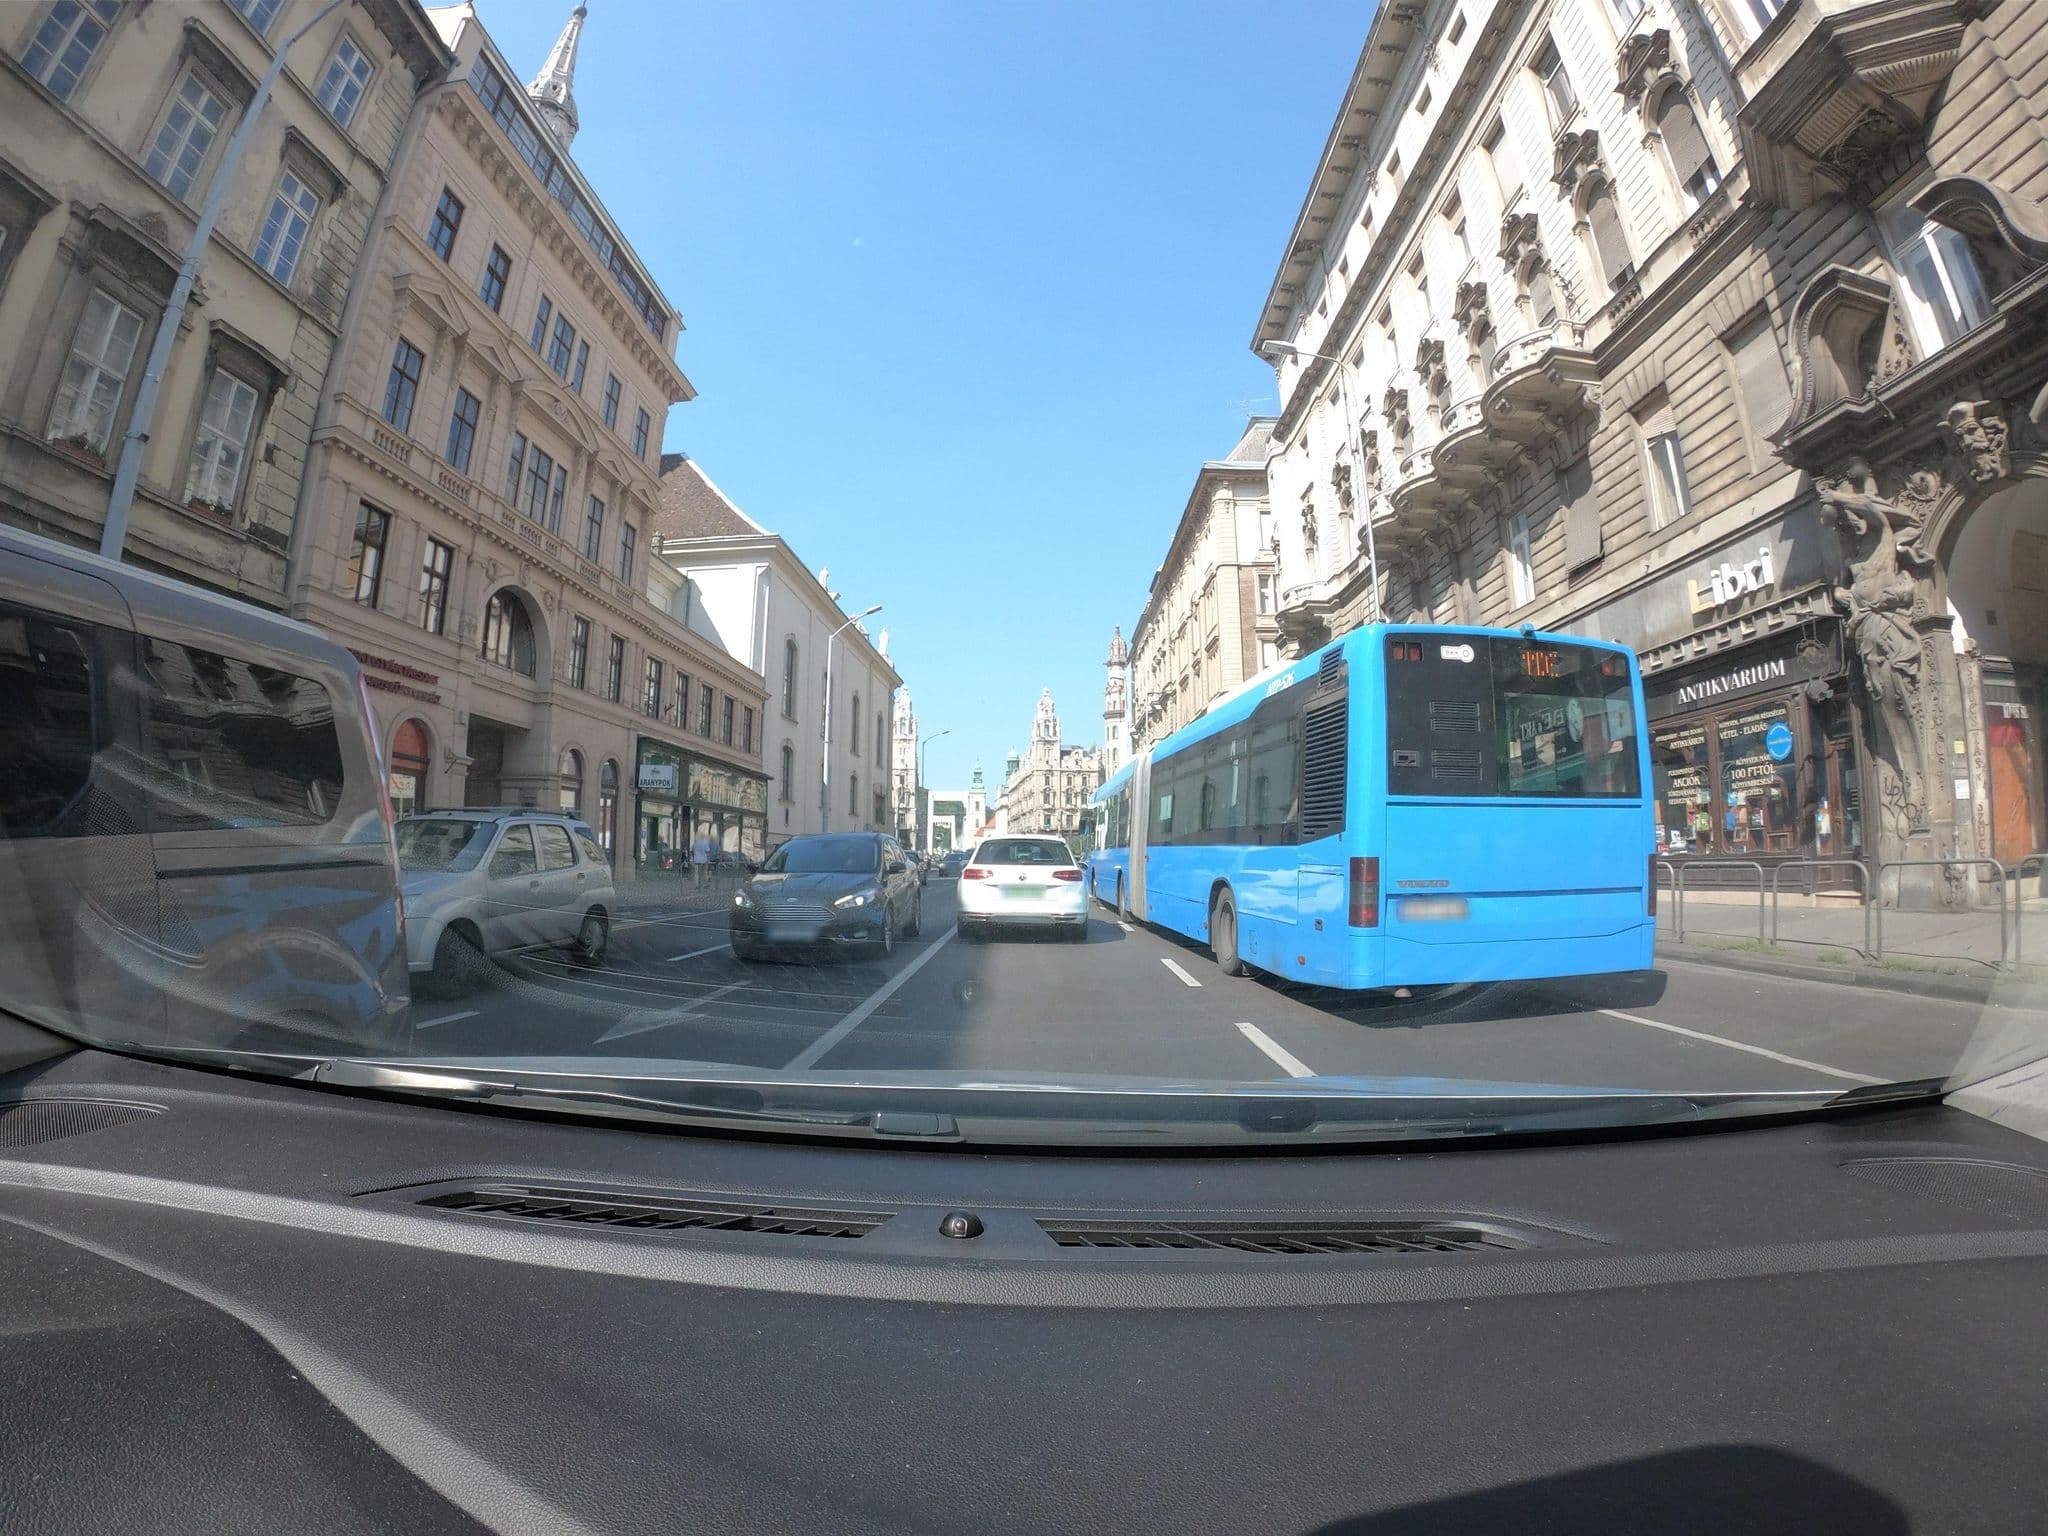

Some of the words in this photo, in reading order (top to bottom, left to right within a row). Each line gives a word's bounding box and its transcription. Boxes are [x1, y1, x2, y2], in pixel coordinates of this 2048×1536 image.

[1688, 547, 1774, 614] Libri
[1678, 659, 1785, 704] ANTIKVÁRIUM
[1719, 729, 1738, 740] VÉTEL
[1743, 722, 1768, 735] ELADÁS
[1673, 772, 1700, 788] AKCIÓK
[1731, 769, 1746, 780] 100
[1747, 762, 1776, 777] FT-TÓL
